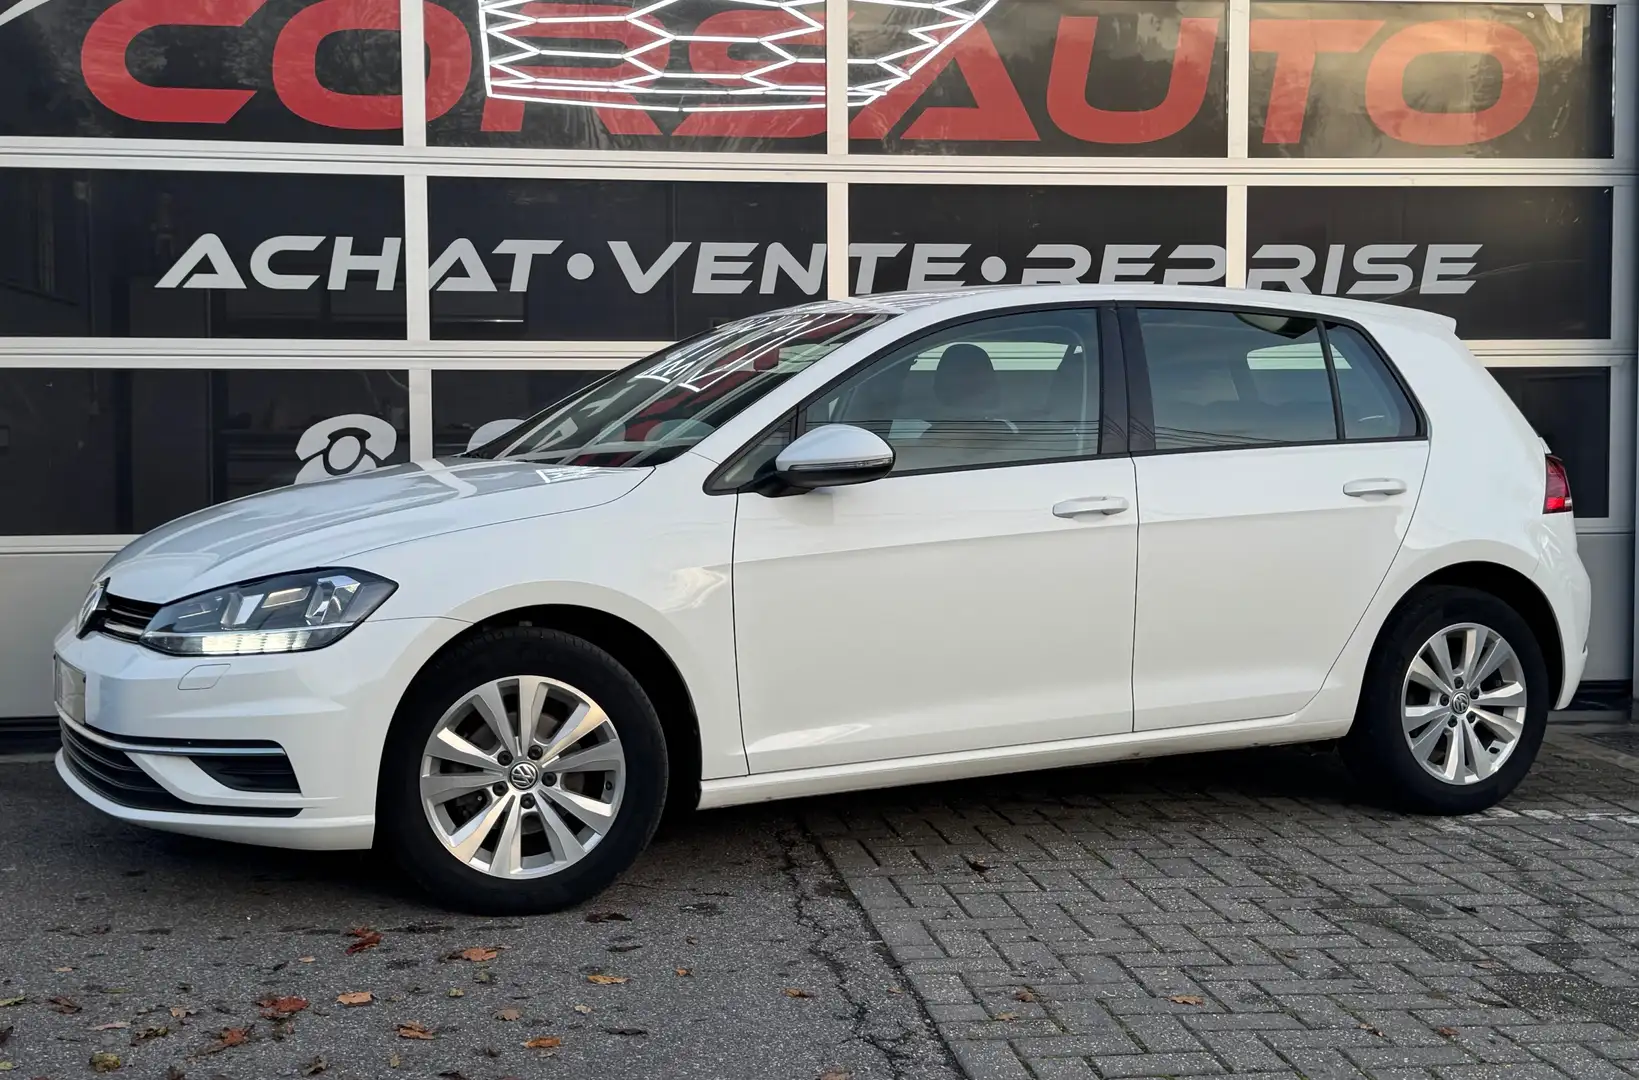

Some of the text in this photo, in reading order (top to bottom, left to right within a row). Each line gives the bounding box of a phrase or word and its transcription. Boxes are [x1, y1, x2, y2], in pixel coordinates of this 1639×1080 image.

[154, 233, 1483, 295] ACHAT VENTE REPRISE
